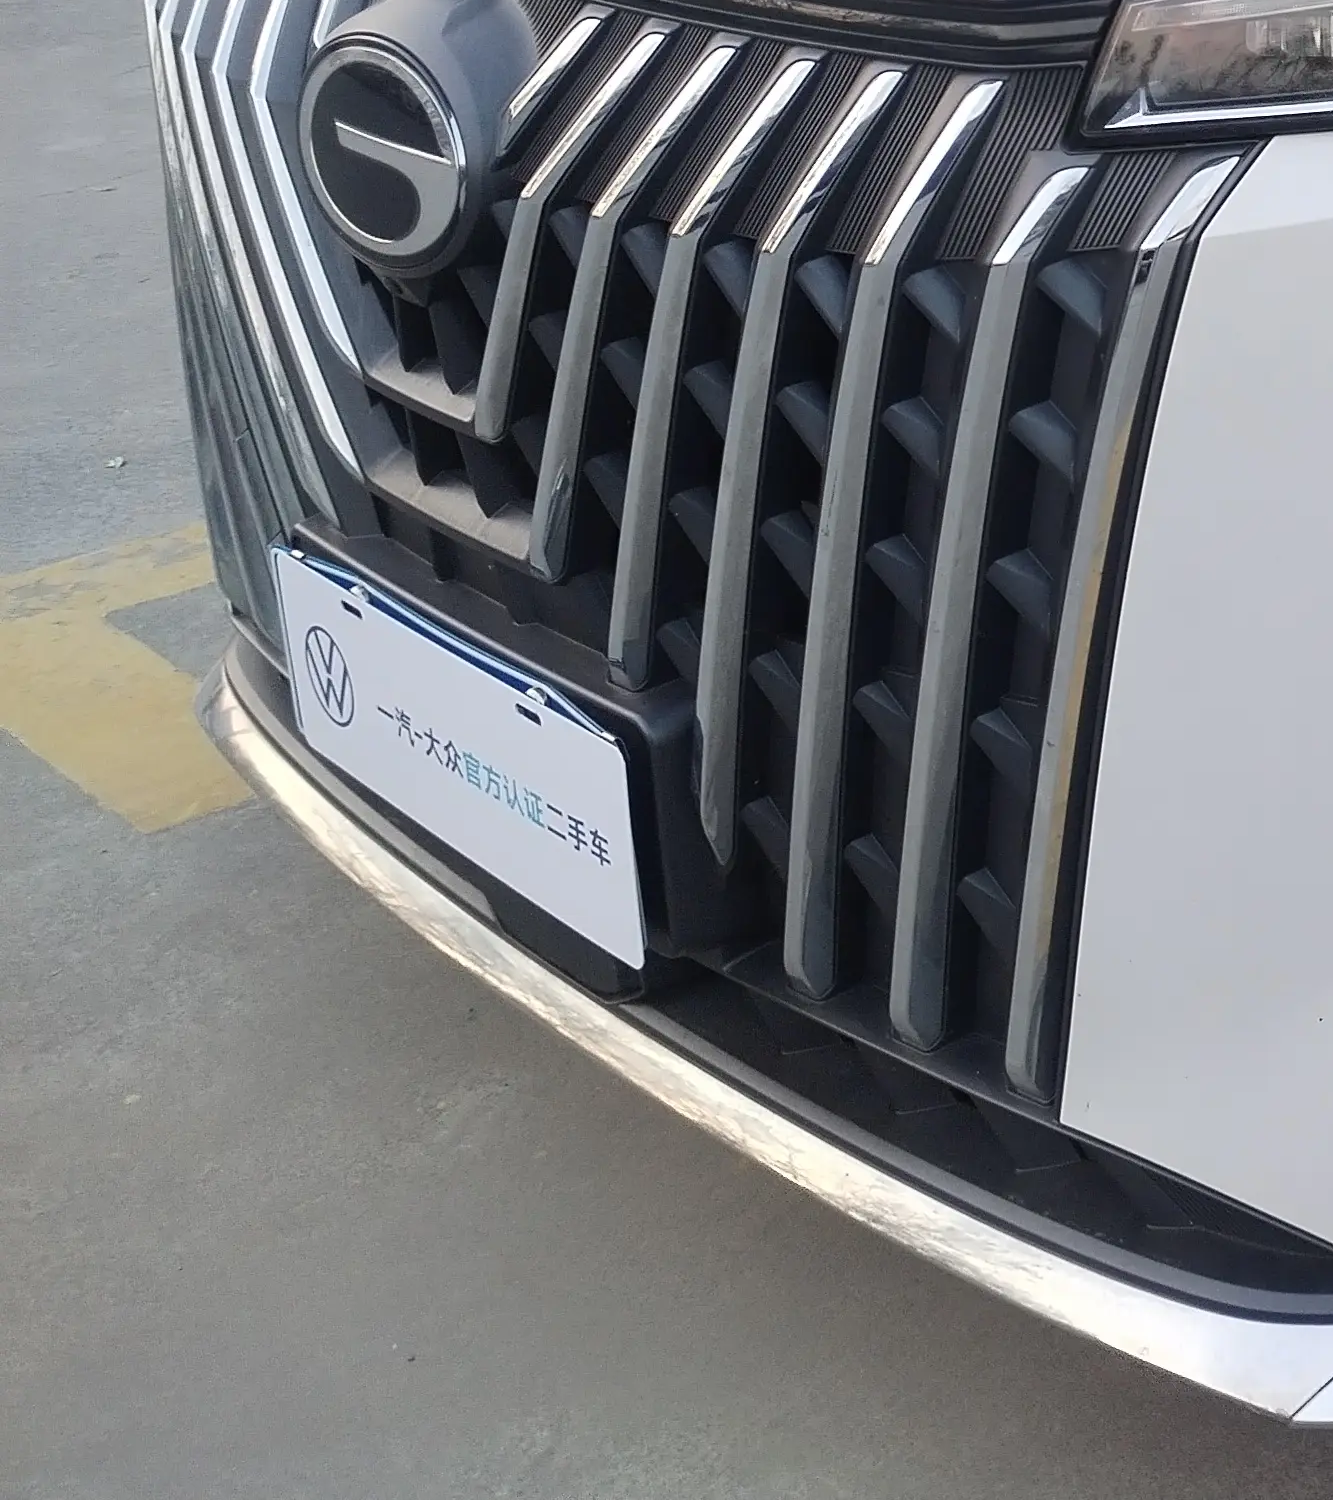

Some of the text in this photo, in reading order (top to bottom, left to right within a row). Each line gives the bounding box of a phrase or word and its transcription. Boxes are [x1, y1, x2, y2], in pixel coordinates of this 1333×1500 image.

[376, 704, 612, 867] 一汽-大众官方认证二手车
